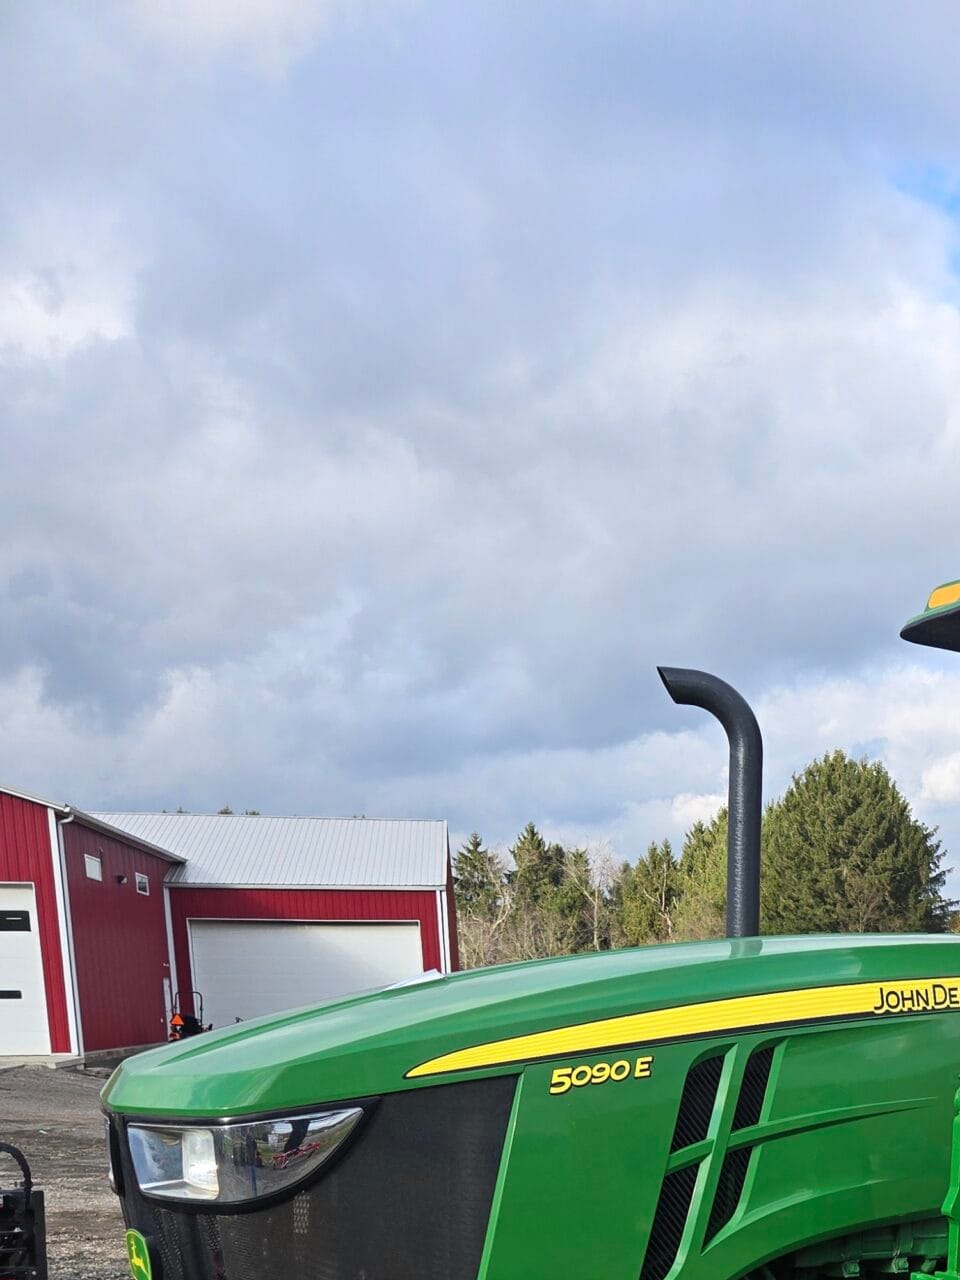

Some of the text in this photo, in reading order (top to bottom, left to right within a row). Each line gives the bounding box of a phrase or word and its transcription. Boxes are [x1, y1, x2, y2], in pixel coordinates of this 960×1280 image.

[874, 987, 931, 1011] JOHN
[549, 1056, 653, 1094] 5090 E
